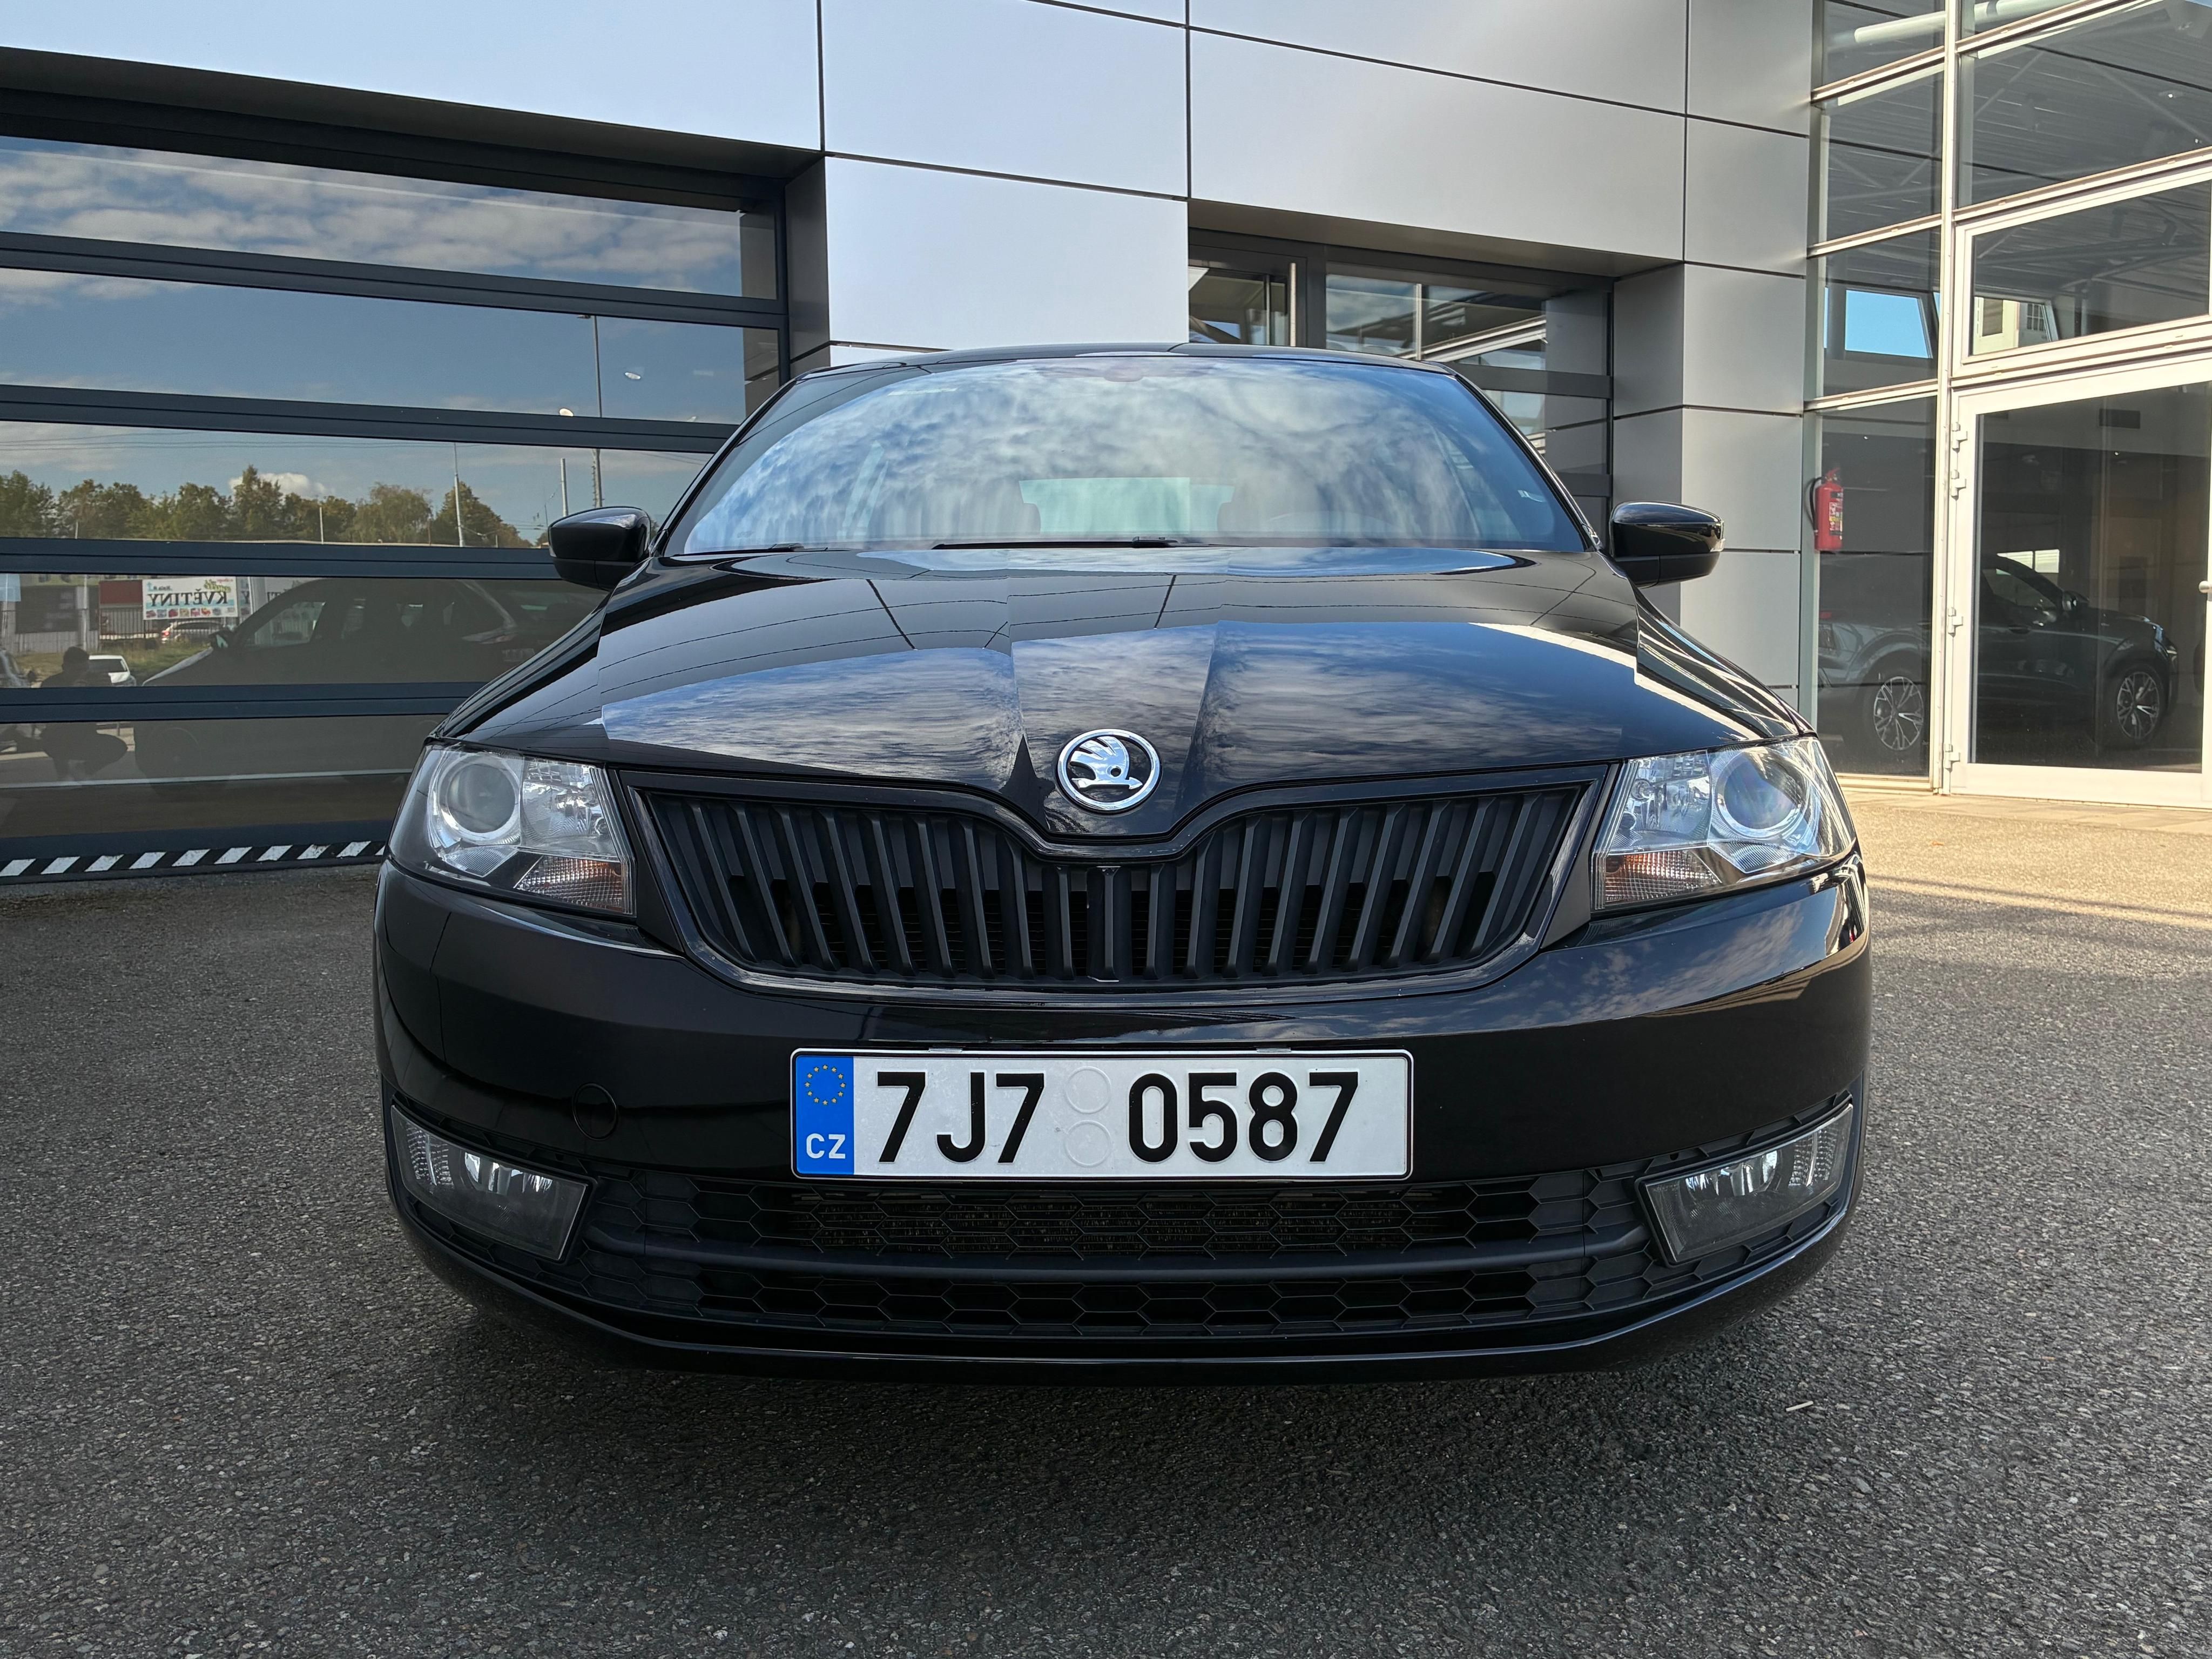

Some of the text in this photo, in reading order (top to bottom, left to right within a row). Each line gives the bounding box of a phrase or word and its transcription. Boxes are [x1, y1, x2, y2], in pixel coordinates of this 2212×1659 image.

[806, 1133, 846, 1159] CZ
[877, 1071, 1359, 1163] 7J7 0587
